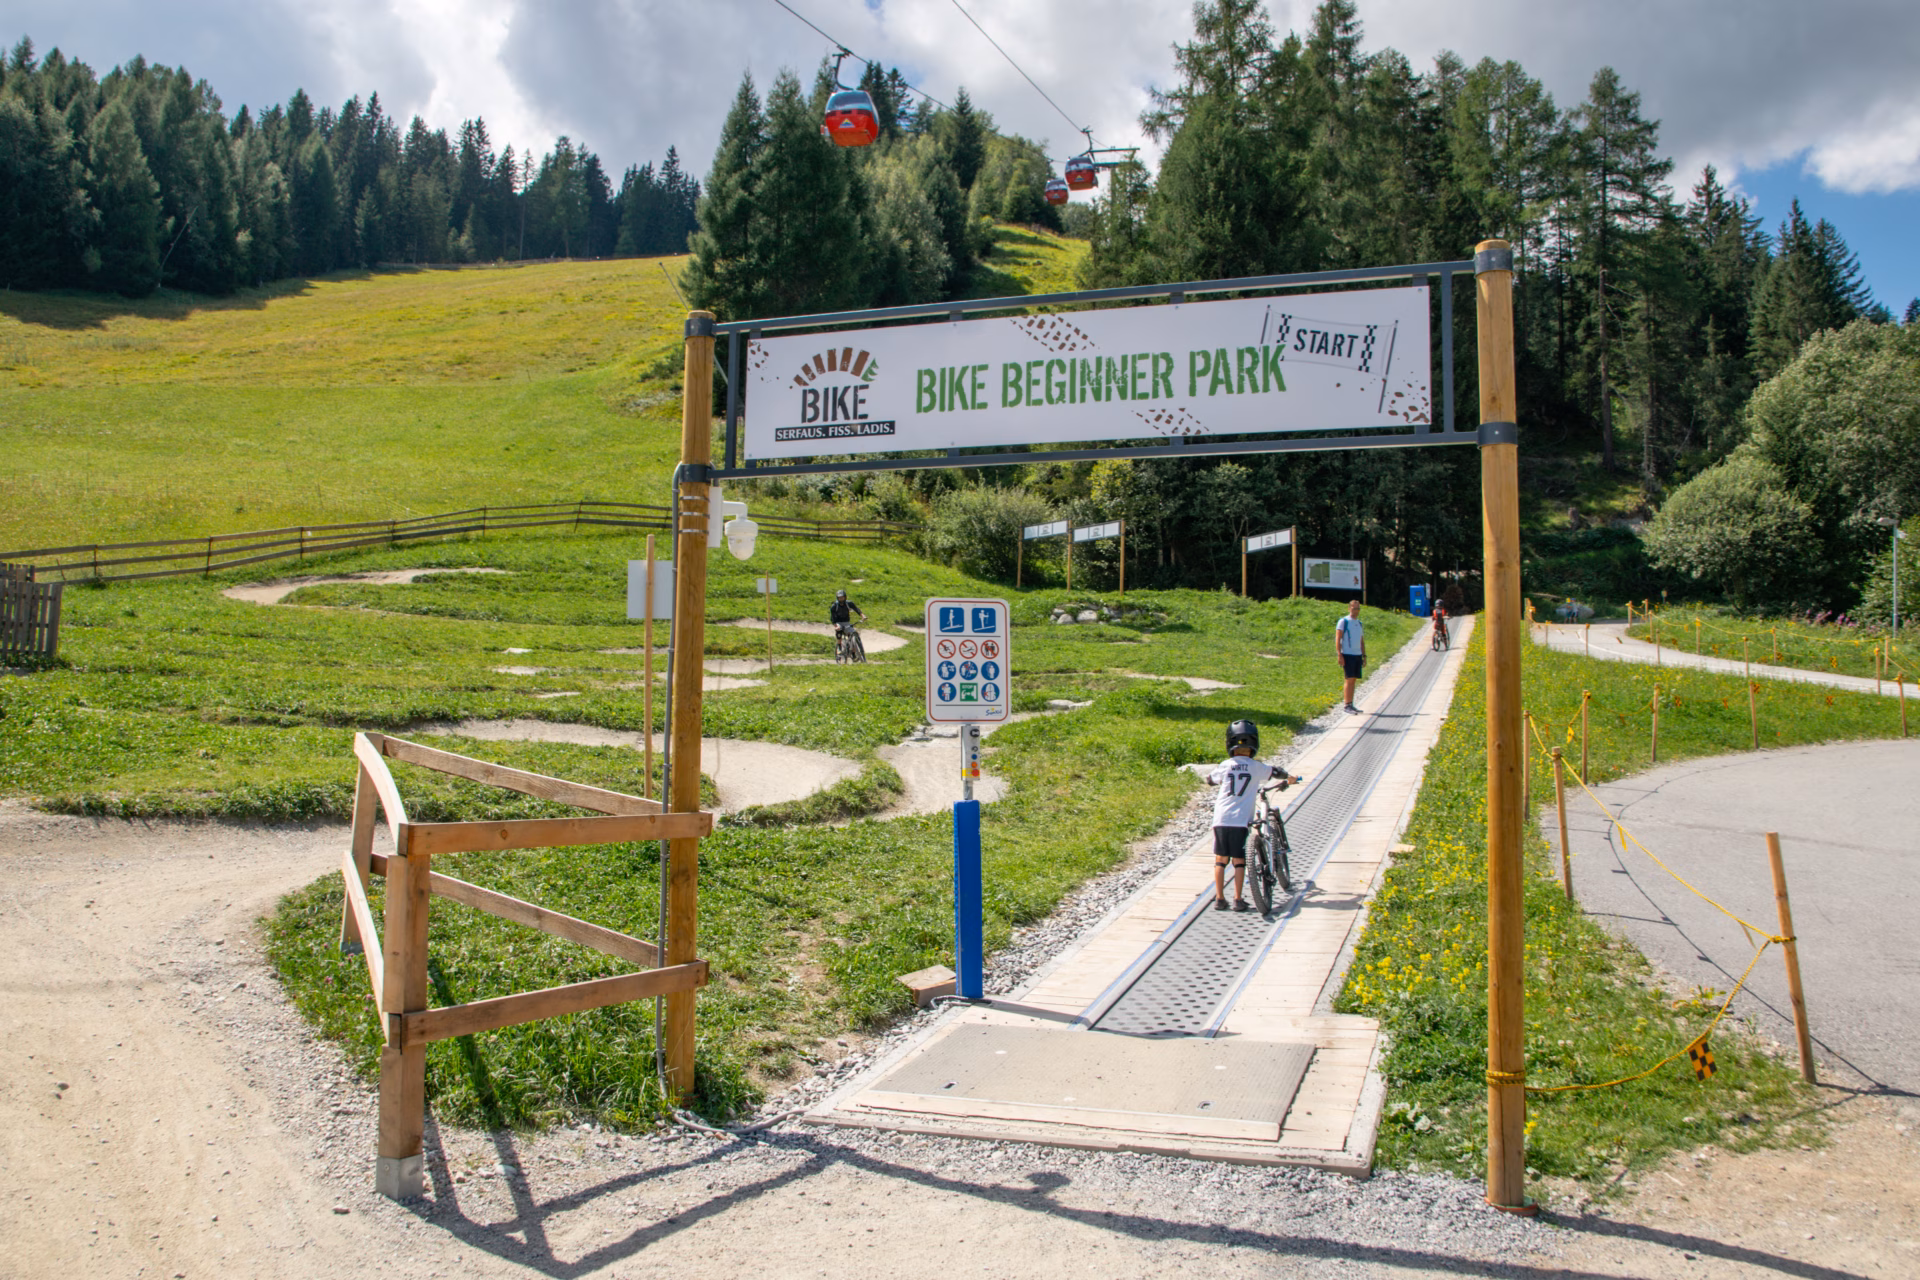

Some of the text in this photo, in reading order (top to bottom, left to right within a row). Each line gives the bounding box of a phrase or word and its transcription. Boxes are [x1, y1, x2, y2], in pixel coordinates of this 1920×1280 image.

[1293, 328, 1359, 358] START
[915, 343, 1287, 414] BIKE BEGINNER PARK
[801, 384, 869, 423] BIKE
[776, 423, 894, 440] SERFAUS. FISS. LADIS.
[1227, 773, 1252, 797] 17
